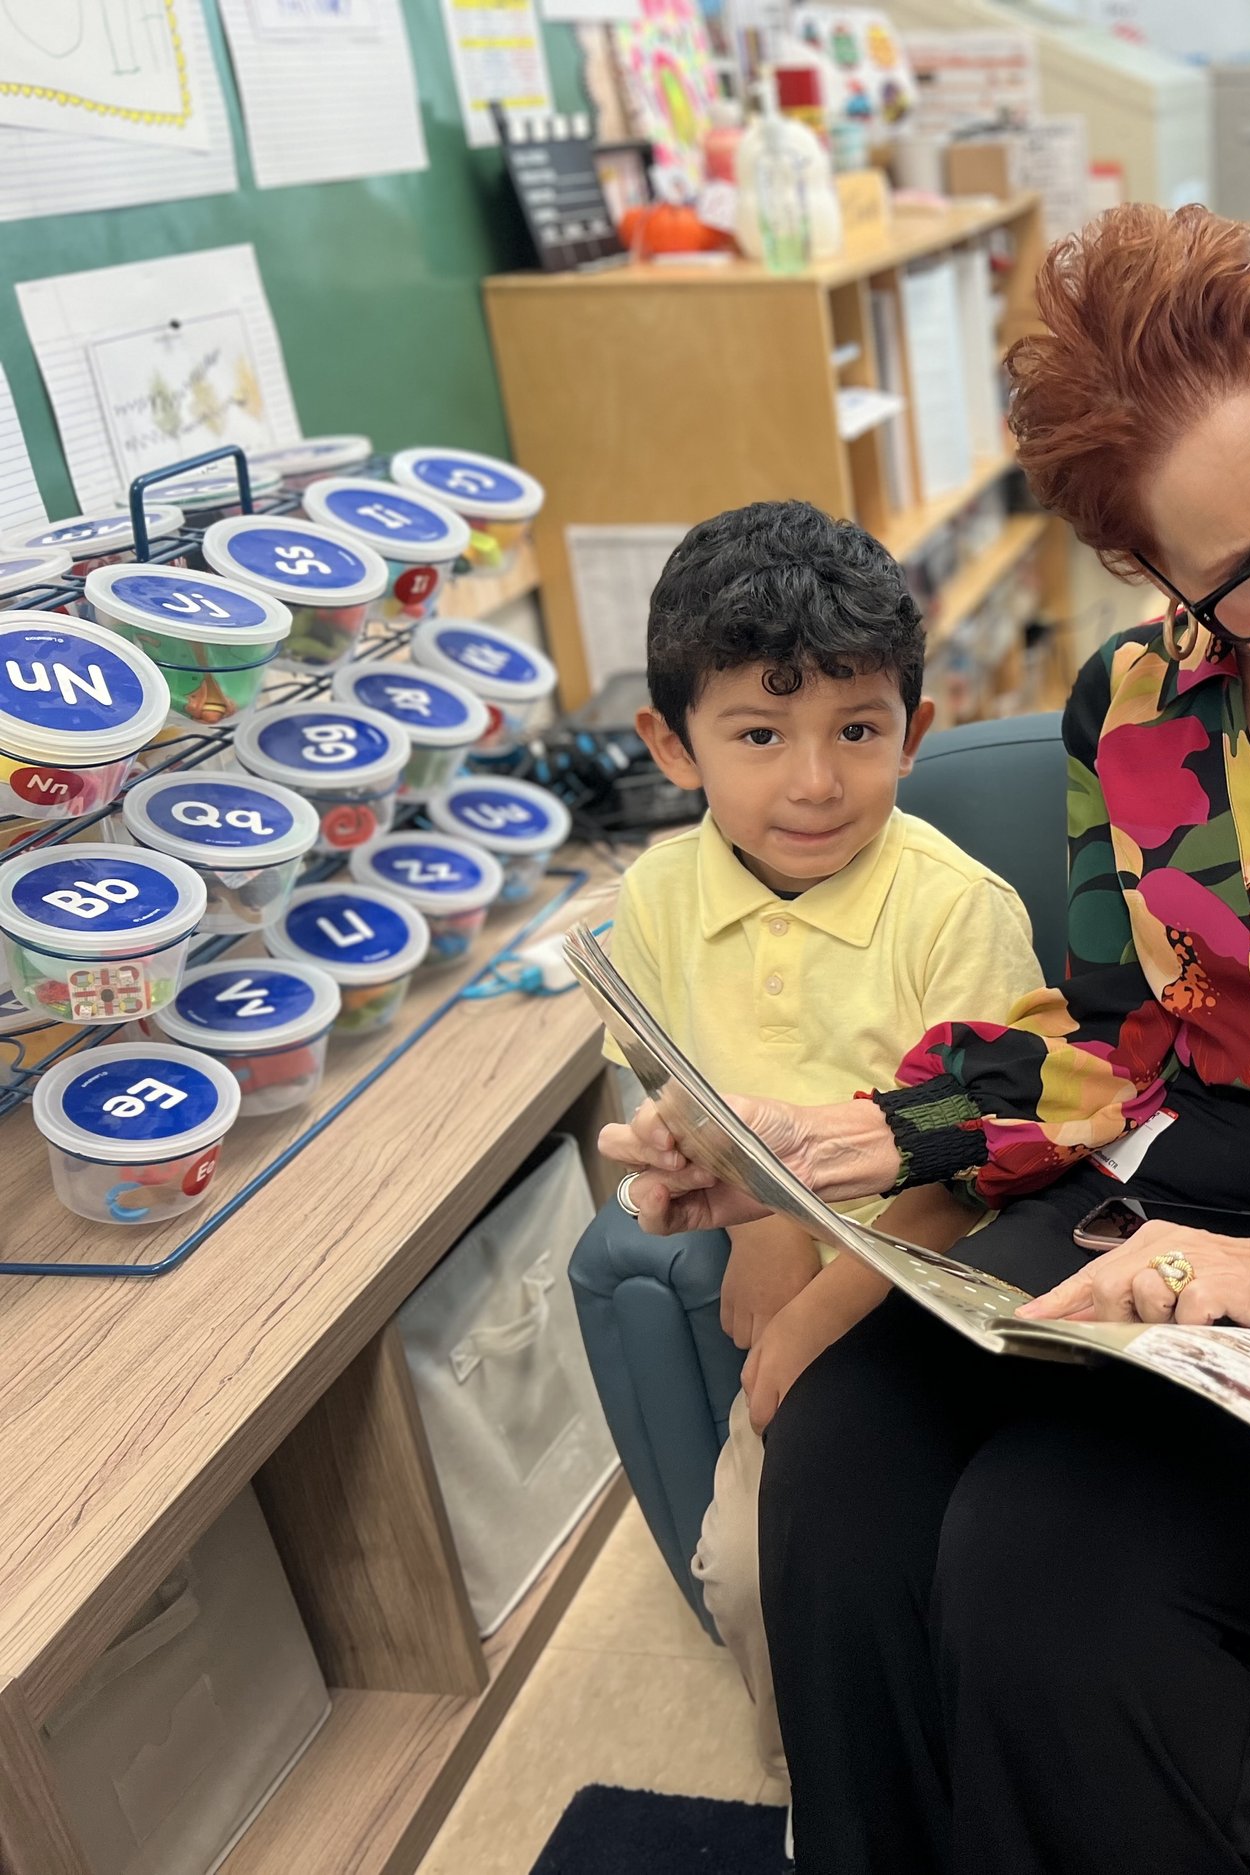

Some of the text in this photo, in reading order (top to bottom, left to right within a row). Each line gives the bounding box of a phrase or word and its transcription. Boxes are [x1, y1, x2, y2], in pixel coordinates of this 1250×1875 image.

[356, 503, 412, 529] Ii
[274, 545, 332, 575] Ss
[408, 574, 428, 594] Ii
[162, 592, 231, 618] Jj
[6, 660, 112, 705] Nn
[302, 724, 357, 764] Gg
[27, 774, 68, 795] Nn
[171, 801, 274, 835] Qq
[393, 859, 463, 884] Zz
[42, 878, 139, 918] Bb
[316, 909, 375, 947] Ll
[215, 978, 275, 1017] Vv
[102, 1078, 188, 1118] Ee
[196, 1161, 215, 1182] Ee
